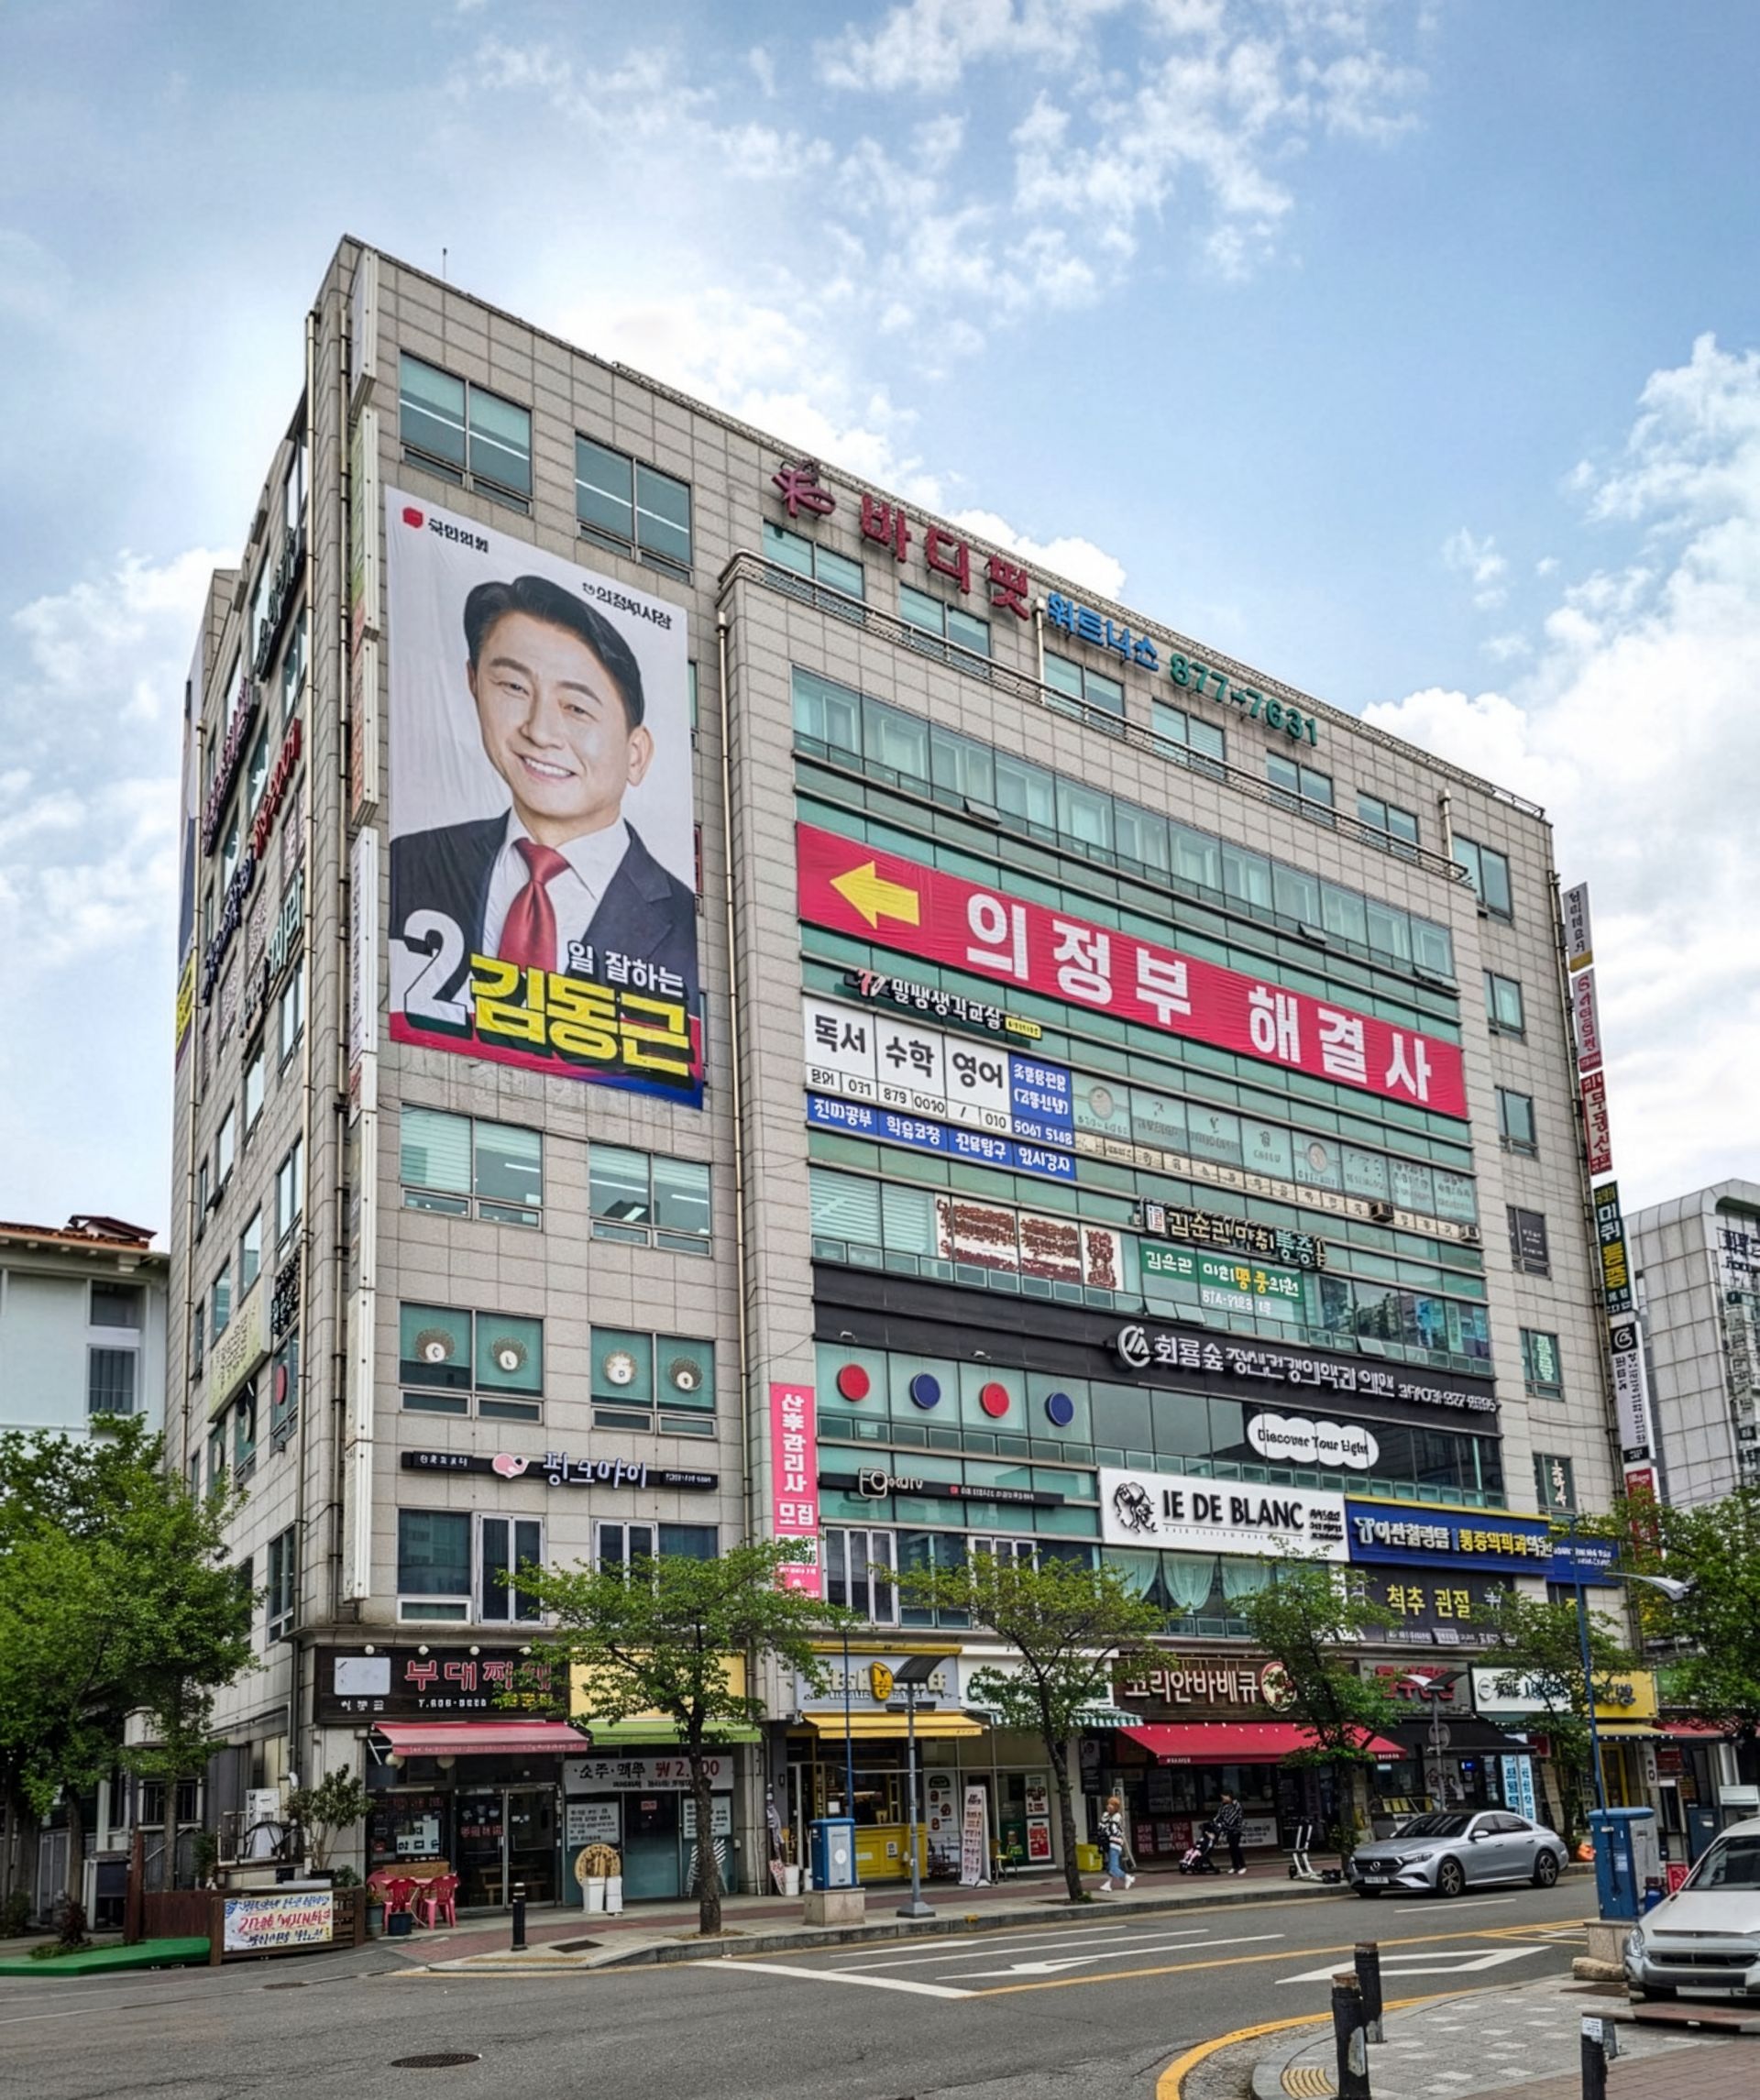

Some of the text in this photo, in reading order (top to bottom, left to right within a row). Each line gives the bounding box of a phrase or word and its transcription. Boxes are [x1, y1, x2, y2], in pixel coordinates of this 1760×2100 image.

[403, 908, 468, 1028] 2
[567, 940, 684, 997] 일 잘하는
[966, 892, 1192, 1026] 의정부
[1248, 986, 1432, 1102] 해결사
[470, 953, 690, 1077] 김동근
[814, 1013, 1004, 1089] 독서 수학 영어
[848, 1078, 872, 1097] 031
[984, 1112, 1006, 1130] 010
[543, 1451, 647, 1490] 핑크아이
[1193, 1492, 1224, 1522] DE
[1230, 1496, 1305, 1531] BLANC
